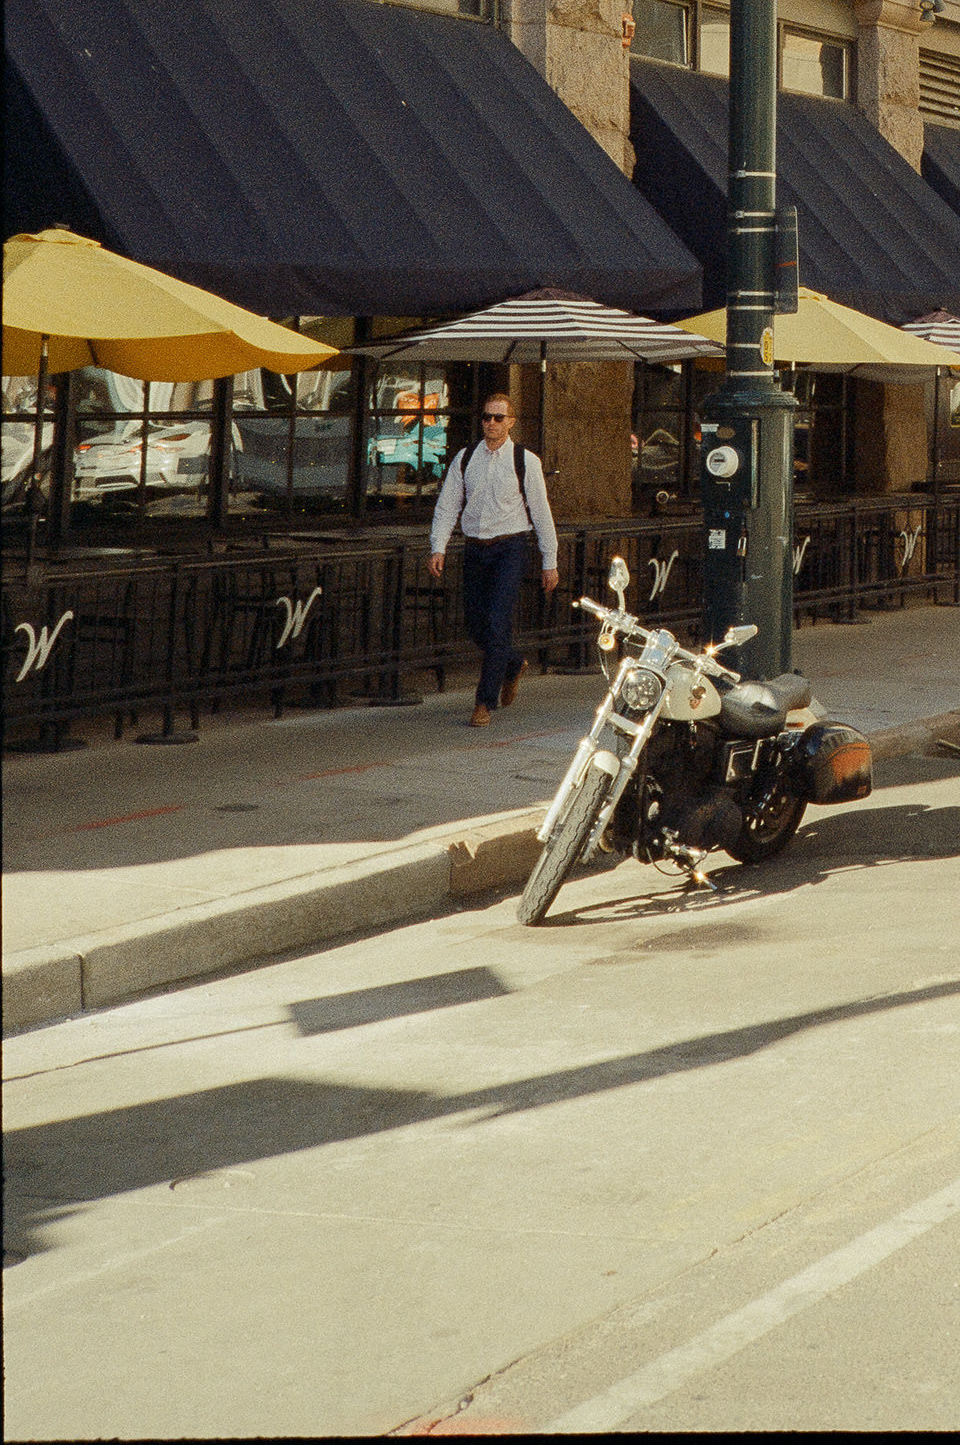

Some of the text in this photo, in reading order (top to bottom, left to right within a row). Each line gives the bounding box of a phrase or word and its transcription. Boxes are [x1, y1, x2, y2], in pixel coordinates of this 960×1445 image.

[900, 525, 921, 566] W
[648, 550, 678, 601] W
[276, 587, 322, 648] W
[15, 610, 73, 682] W
